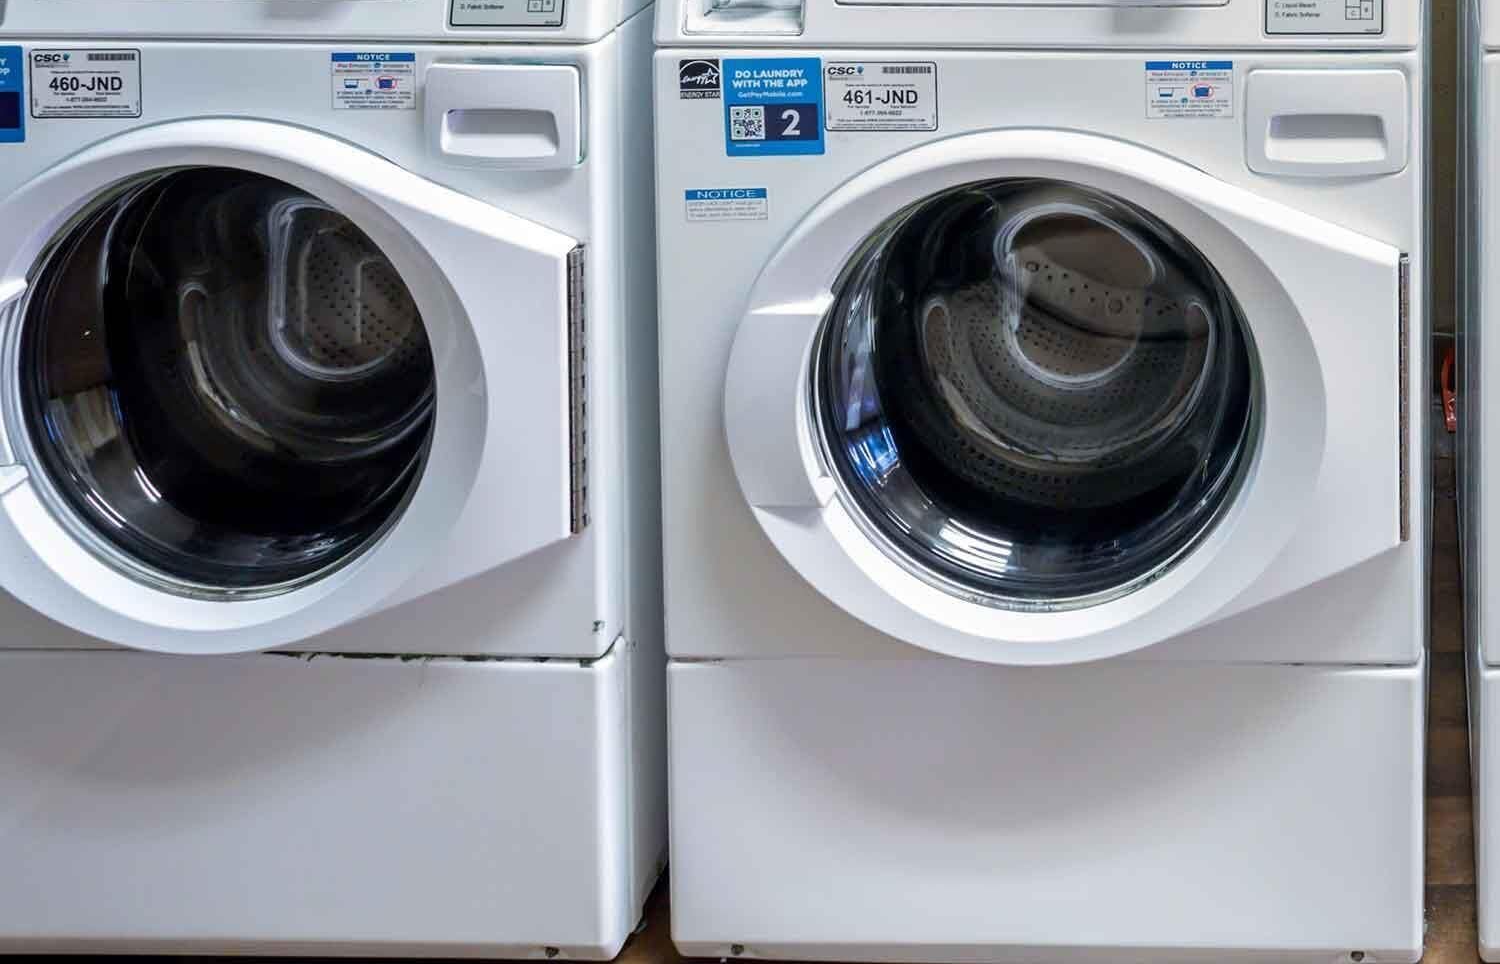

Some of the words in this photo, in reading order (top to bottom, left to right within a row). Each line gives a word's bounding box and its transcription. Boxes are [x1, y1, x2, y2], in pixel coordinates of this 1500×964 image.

[34, 54, 61, 62] CSC
[735, 70, 751, 79] DO
[753, 69, 804, 78] LAUNDRY
[828, 66, 855, 75] CSC
[48, 76, 123, 91] 460-JND
[732, 79, 760, 89] WITH
[763, 79, 784, 88] THE
[786, 79, 808, 88] APP
[843, 89, 918, 105] 461-JND
[781, 109, 801, 136] 2
[696, 190, 755, 199] NOTICE
